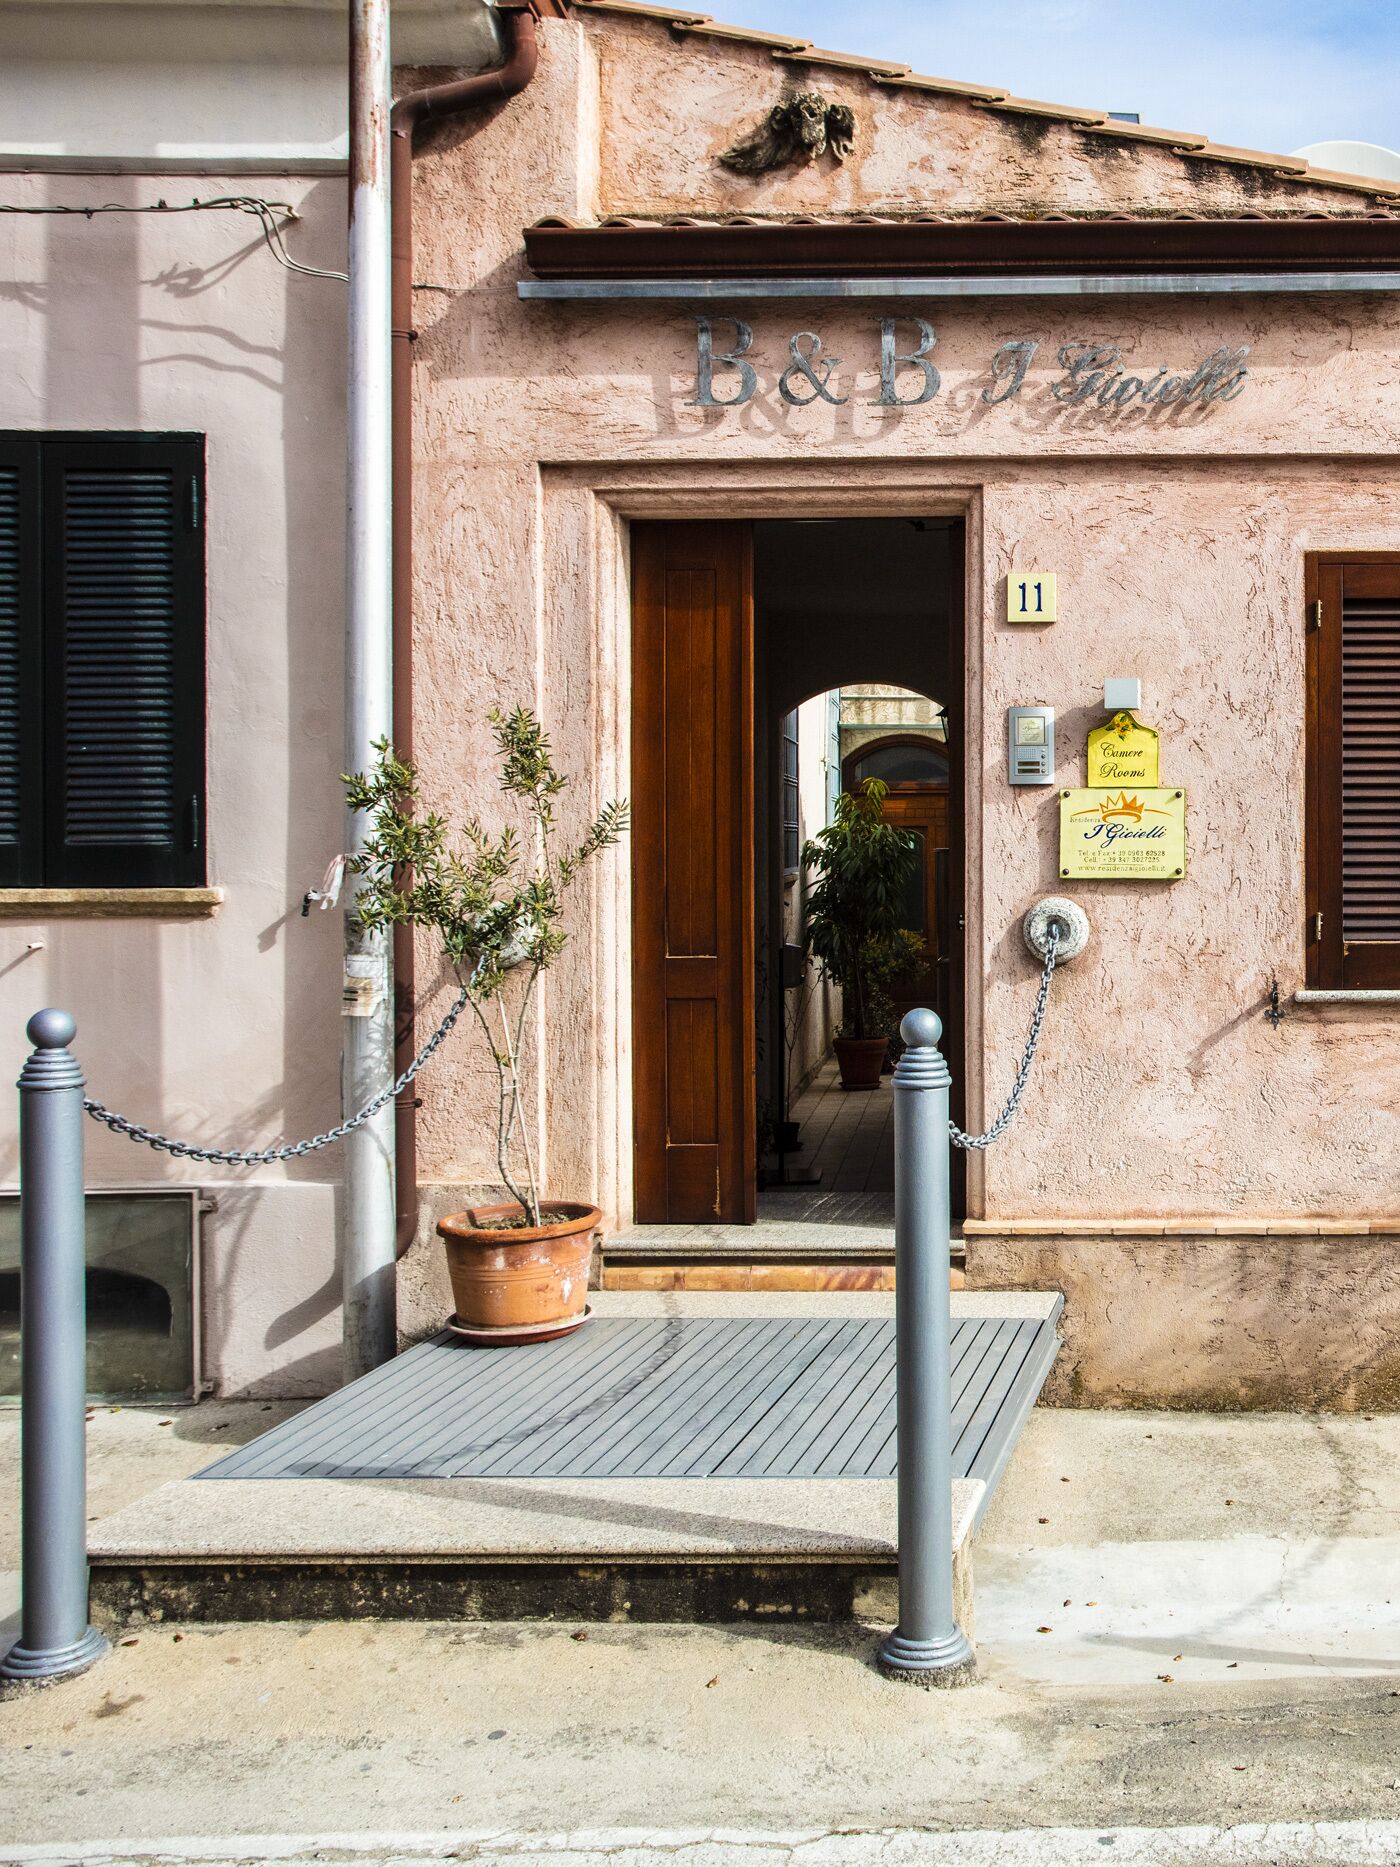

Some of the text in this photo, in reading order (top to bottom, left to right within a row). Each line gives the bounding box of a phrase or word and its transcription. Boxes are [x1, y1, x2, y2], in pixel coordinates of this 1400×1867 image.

[1052, 342, 1250, 406] Gioielli
[1018, 582, 1043, 612] 11
[1100, 741, 1144, 758] Camere
[1099, 761, 1146, 778] Rooms
[1083, 822, 1167, 849] I Gioielli
